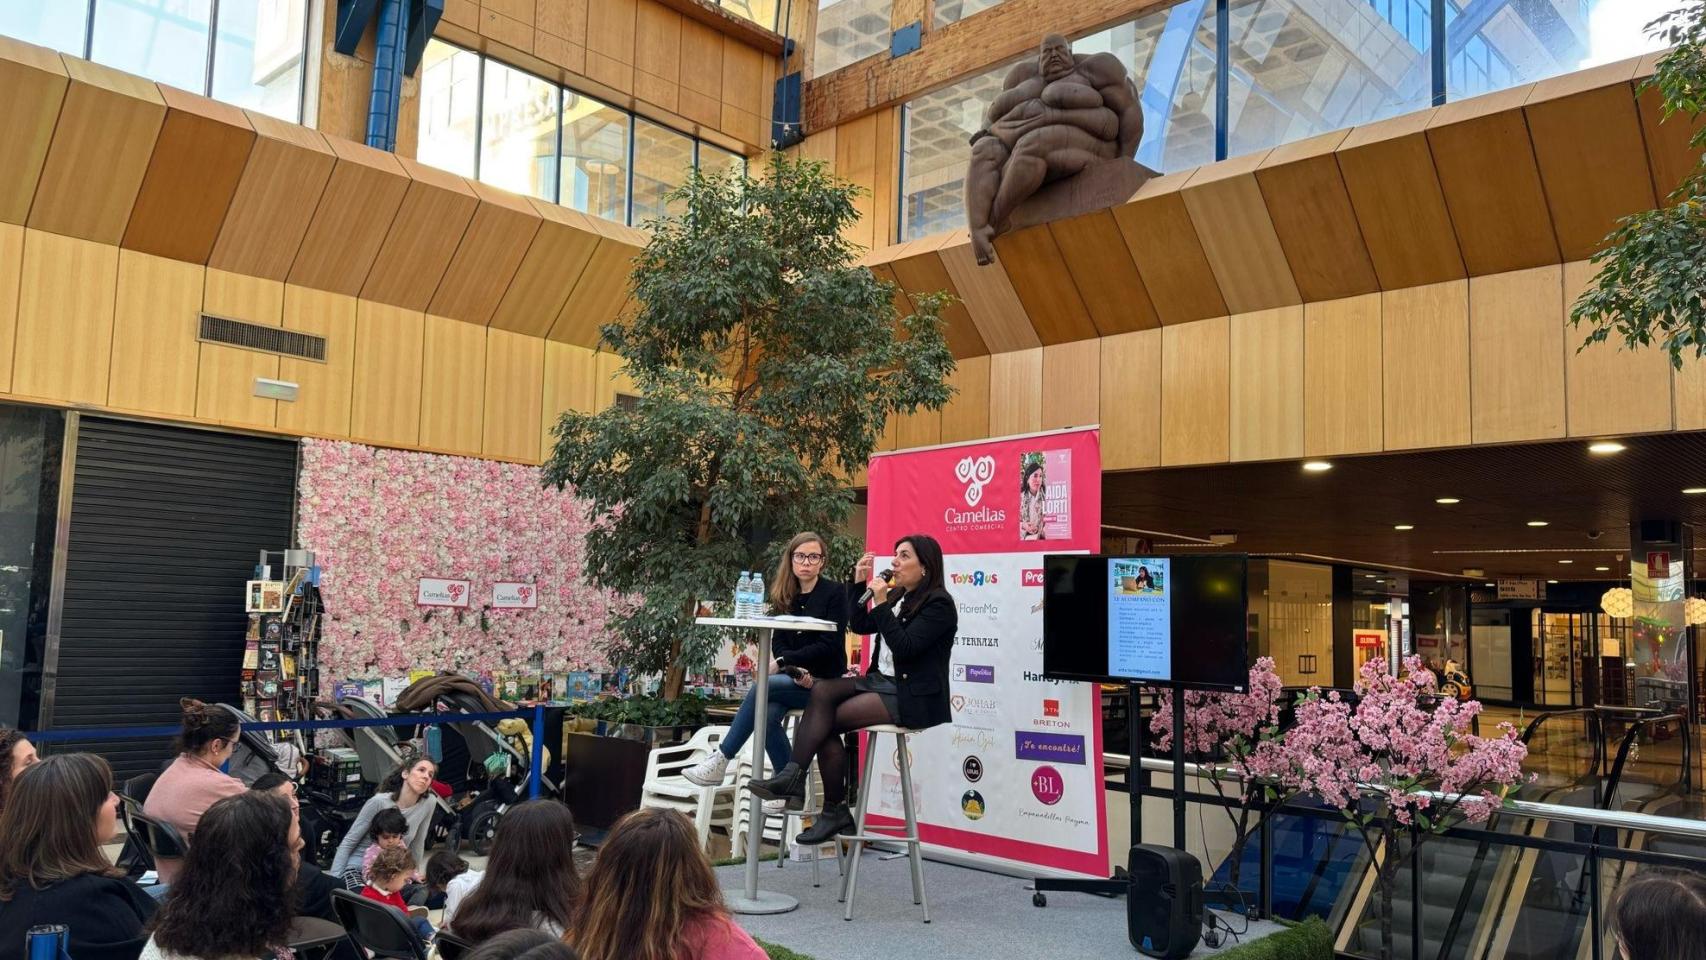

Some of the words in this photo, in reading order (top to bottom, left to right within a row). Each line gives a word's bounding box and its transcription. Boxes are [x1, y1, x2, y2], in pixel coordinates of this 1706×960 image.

[1045, 485, 1067, 499] AIDA
[1042, 499, 1067, 513] LORTI
[944, 506, 1006, 523] Camelias
[1033, 719, 1071, 728] BRETON
